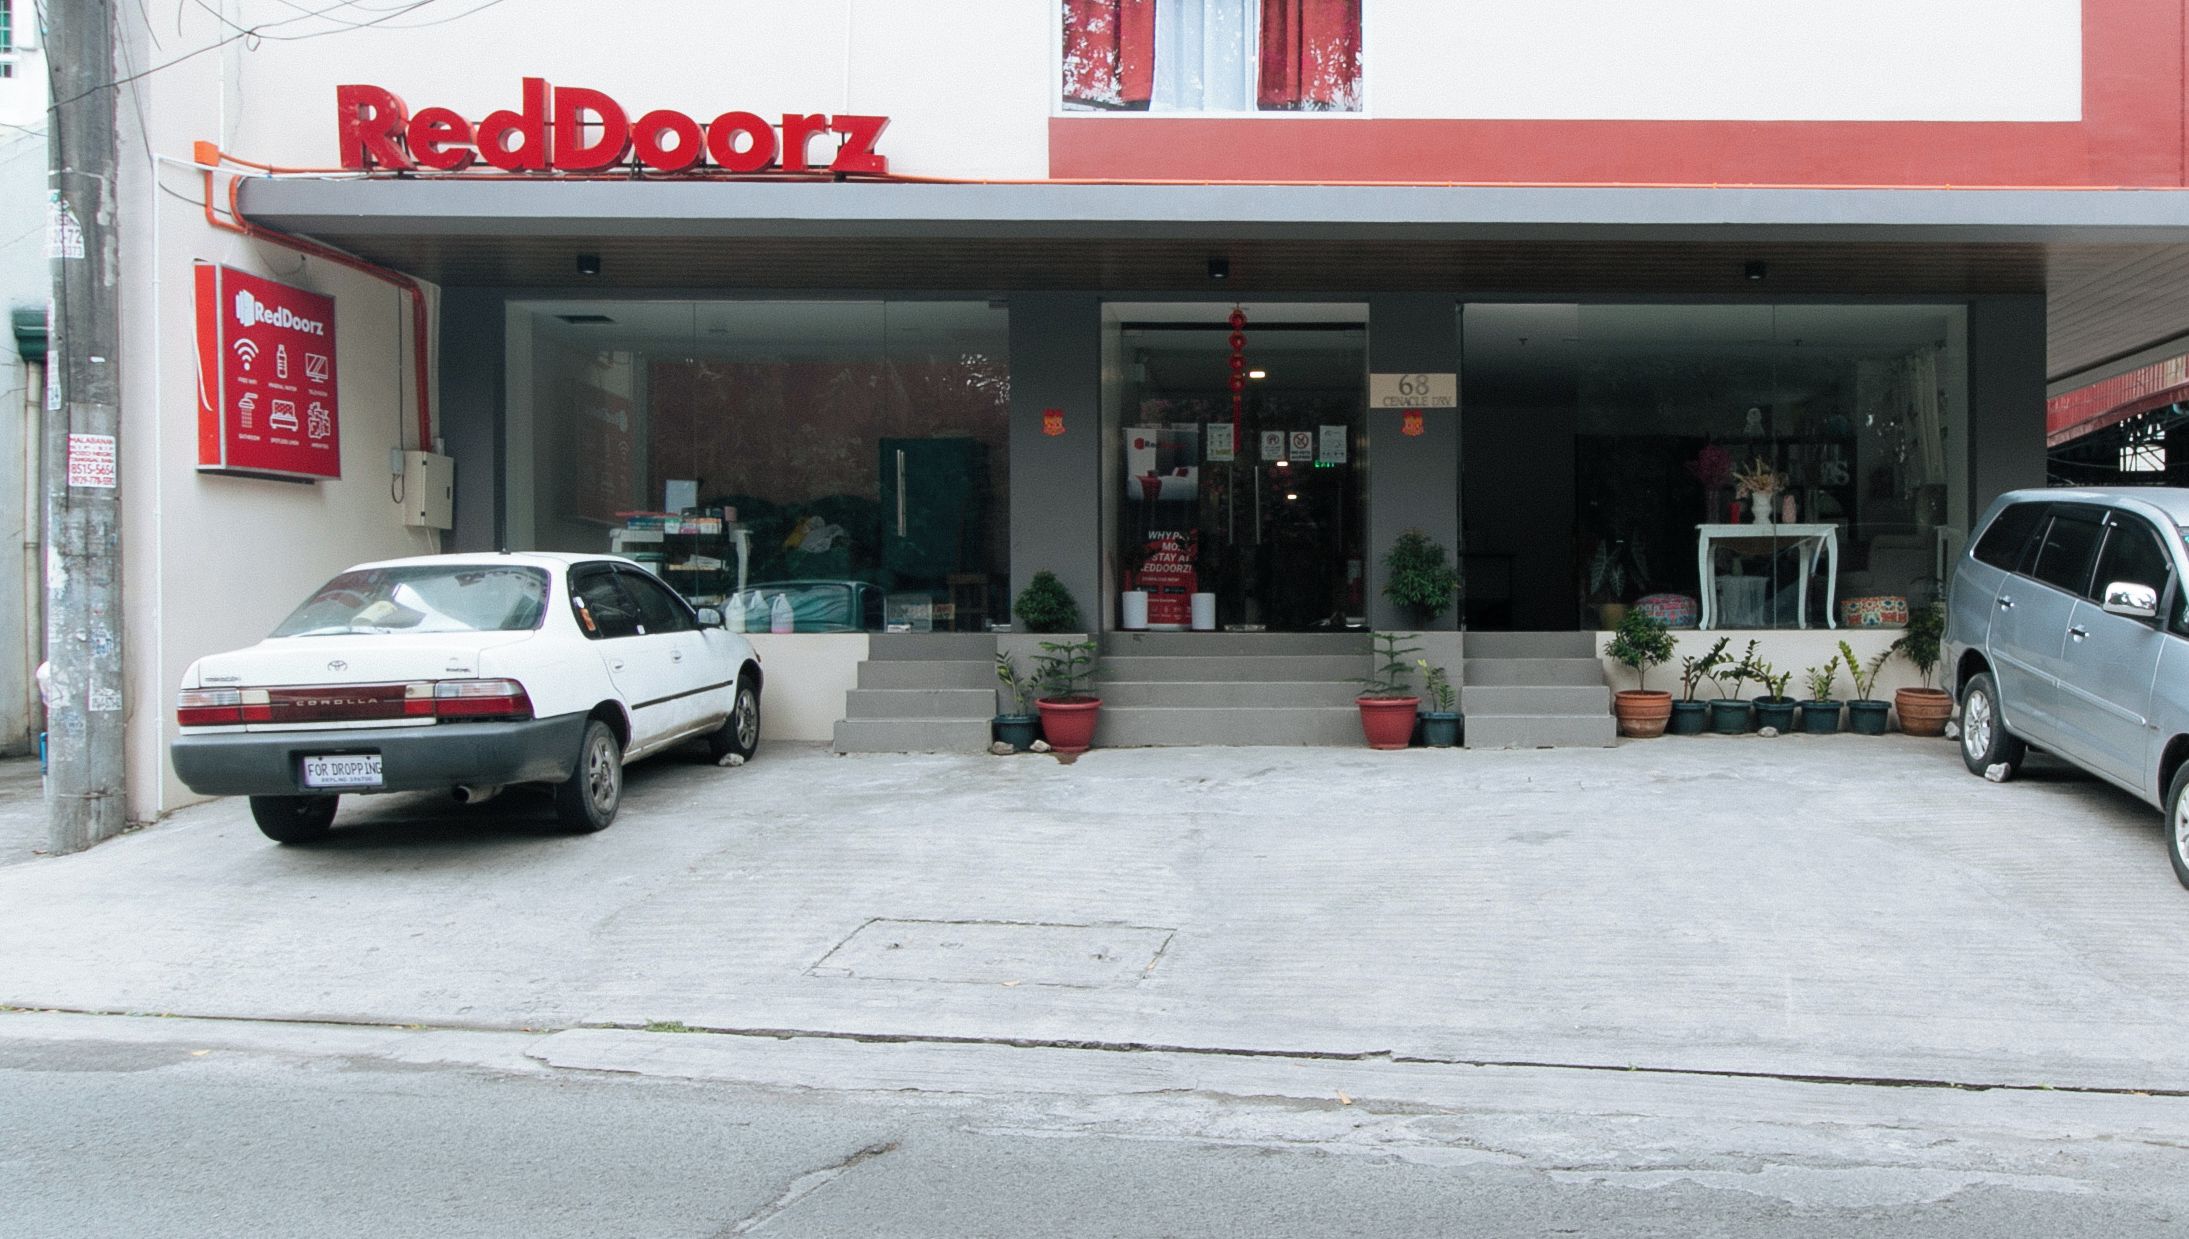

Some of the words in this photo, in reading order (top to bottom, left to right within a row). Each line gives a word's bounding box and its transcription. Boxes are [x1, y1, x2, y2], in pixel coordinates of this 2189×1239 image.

[336, 76, 890, 174] RedDoorz
[254, 301, 324, 335] RedDoorz
[1399, 374, 1429, 396] 68
[1148, 530, 1172, 540] WHY
[1152, 552, 1177, 562] STAY
[1141, 562, 1192, 574] EDDOORZ!
[296, 697, 378, 707] COROLLA
[307, 763, 328, 777] FOR
[331, 761, 383, 776] DROPPING
